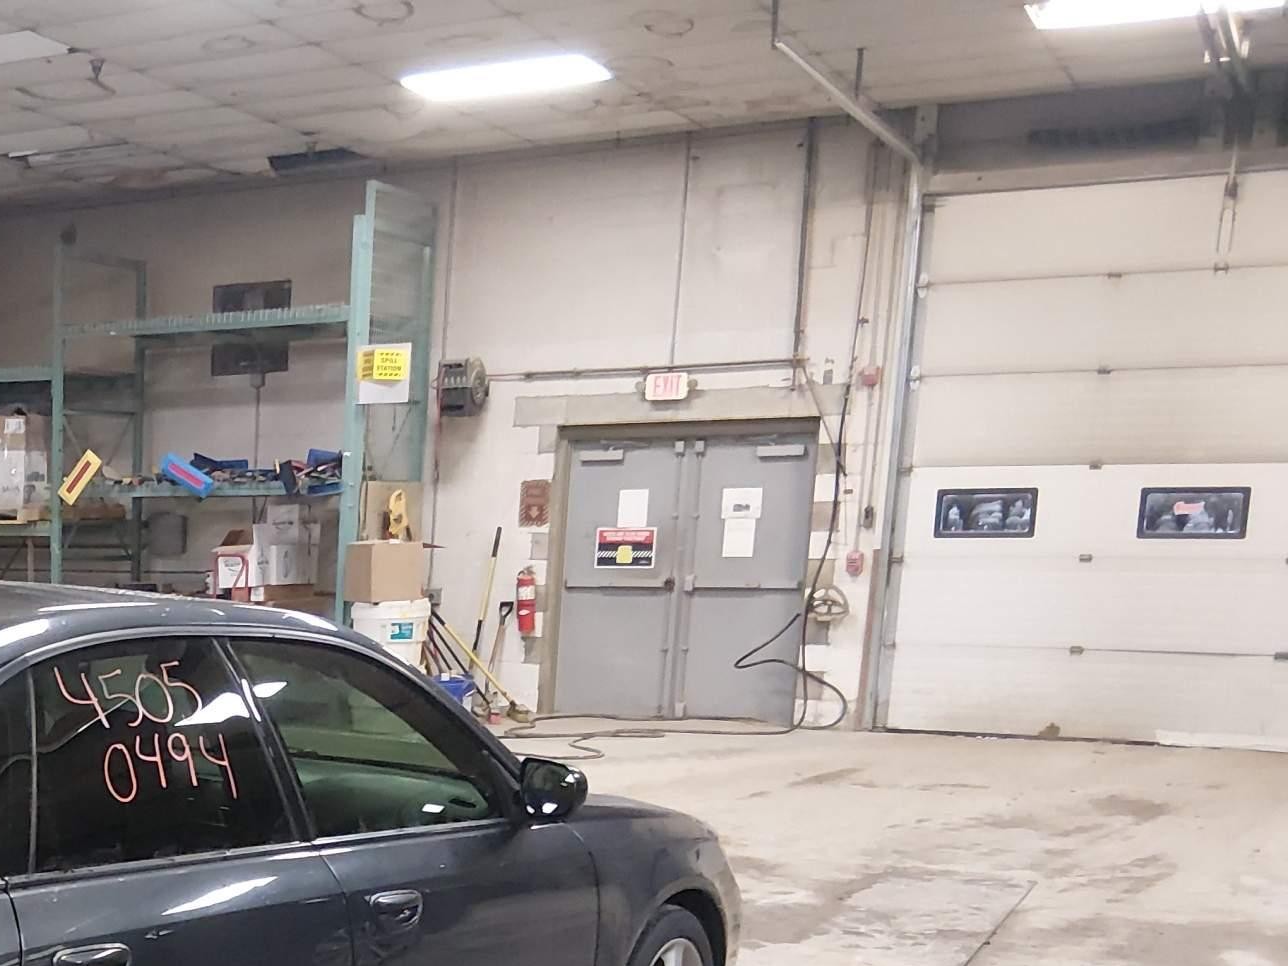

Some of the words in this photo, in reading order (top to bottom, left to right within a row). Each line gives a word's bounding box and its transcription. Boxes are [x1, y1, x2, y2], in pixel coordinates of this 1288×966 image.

[653, 375, 681, 397] EXIT
[54, 660, 202, 728] 4505
[104, 733, 238, 803] 0494
